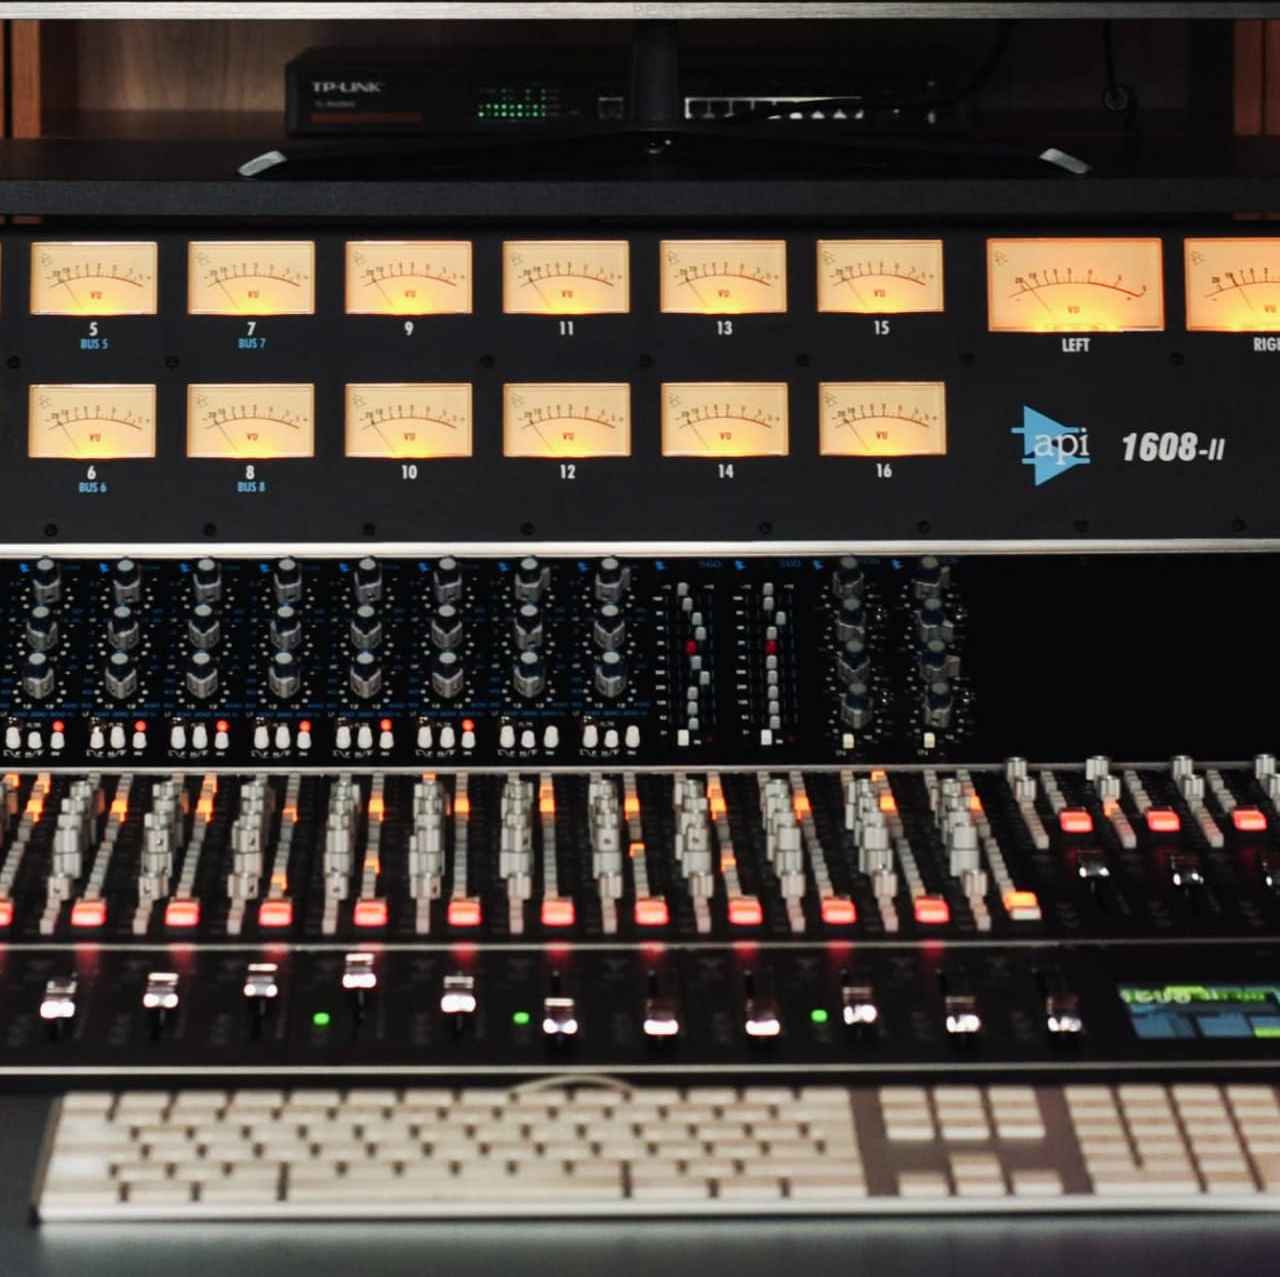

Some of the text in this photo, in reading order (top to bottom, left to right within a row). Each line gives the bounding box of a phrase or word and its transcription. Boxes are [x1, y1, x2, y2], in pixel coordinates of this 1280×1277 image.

[312, 81, 381, 93] TP-LINK
[90, 322, 97, 336] 5
[248, 322, 256, 335] 7
[405, 322, 413, 335] 9
[560, 321, 573, 335] 11
[718, 321, 732, 335] 13
[875, 321, 889, 334] 15
[80, 338, 109, 350] BUS 5
[238, 337, 266, 349] BUS 7
[1062, 338, 1090, 352] LEFT
[1034, 427, 1090, 465] api
[88, 466, 96, 479] 6
[246, 465, 254, 479] 8
[402, 465, 417, 479] 10
[561, 465, 575, 478] 12
[719, 464, 733, 478] 14
[877, 464, 892, 477] 16
[78, 481, 99, 493] BUS
[237, 481, 257, 493] BUS
